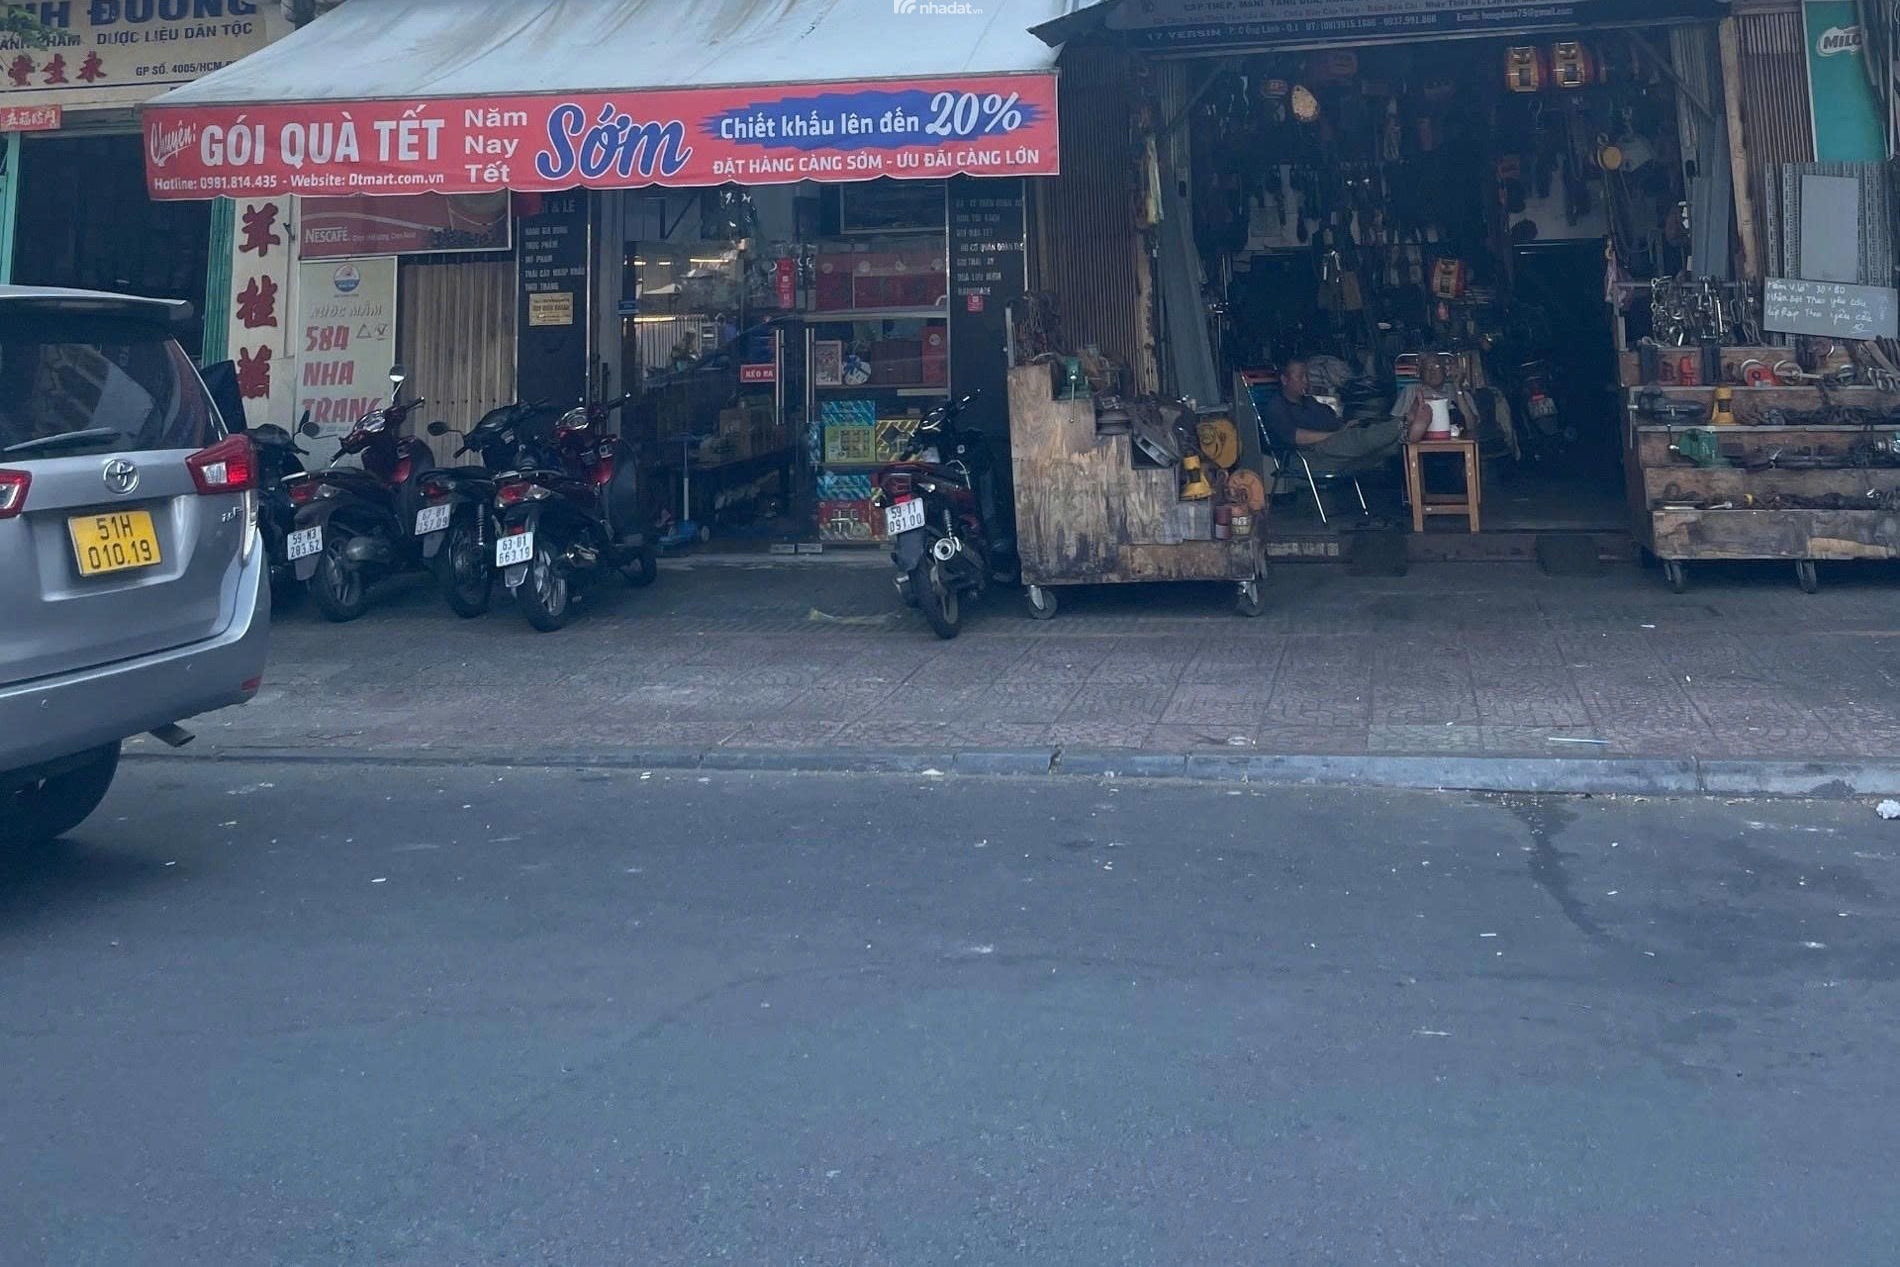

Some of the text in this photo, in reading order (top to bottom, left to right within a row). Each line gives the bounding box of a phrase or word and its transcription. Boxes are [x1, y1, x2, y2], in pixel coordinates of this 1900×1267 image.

[144, 27, 179, 43] LIỆU
[184, 23, 217, 39] DÂN
[221, 20, 252, 37] TỘC
[136, 66, 150, 76] GP
[464, 108, 528, 128] Năm
[721, 92, 1022, 139] Chiết khấu lên đến 20%
[201, 115, 265, 167] GÓI
[280, 111, 360, 169] QUÀ
[373, 104, 445, 162] TẾT
[465, 135, 519, 159] Nay
[535, 102, 693, 180] Sớm
[465, 160, 510, 183] Tết
[713, 156, 745, 177] ĐẶT
[750, 155, 794, 174] HÀNG
[799, 153, 842, 172] CÀNG
[847, 151, 882, 170] SỚM
[897, 152, 919, 168] ƯU
[924, 149, 952, 167] ĐÃI
[956, 148, 1001, 166] CÀNG
[1006, 146, 1039, 165] LỚN
[154, 178, 197, 190] Hotline:
[200, 175, 277, 189] 0981.814.435
[291, 174, 345, 187] Website:
[349, 173, 444, 186] Dtmart.com.vn
[305, 325, 350, 352] 584
[303, 360, 355, 386] NHA
[95, 516, 134, 541] 51H
[88, 539, 152, 570] 010.19
